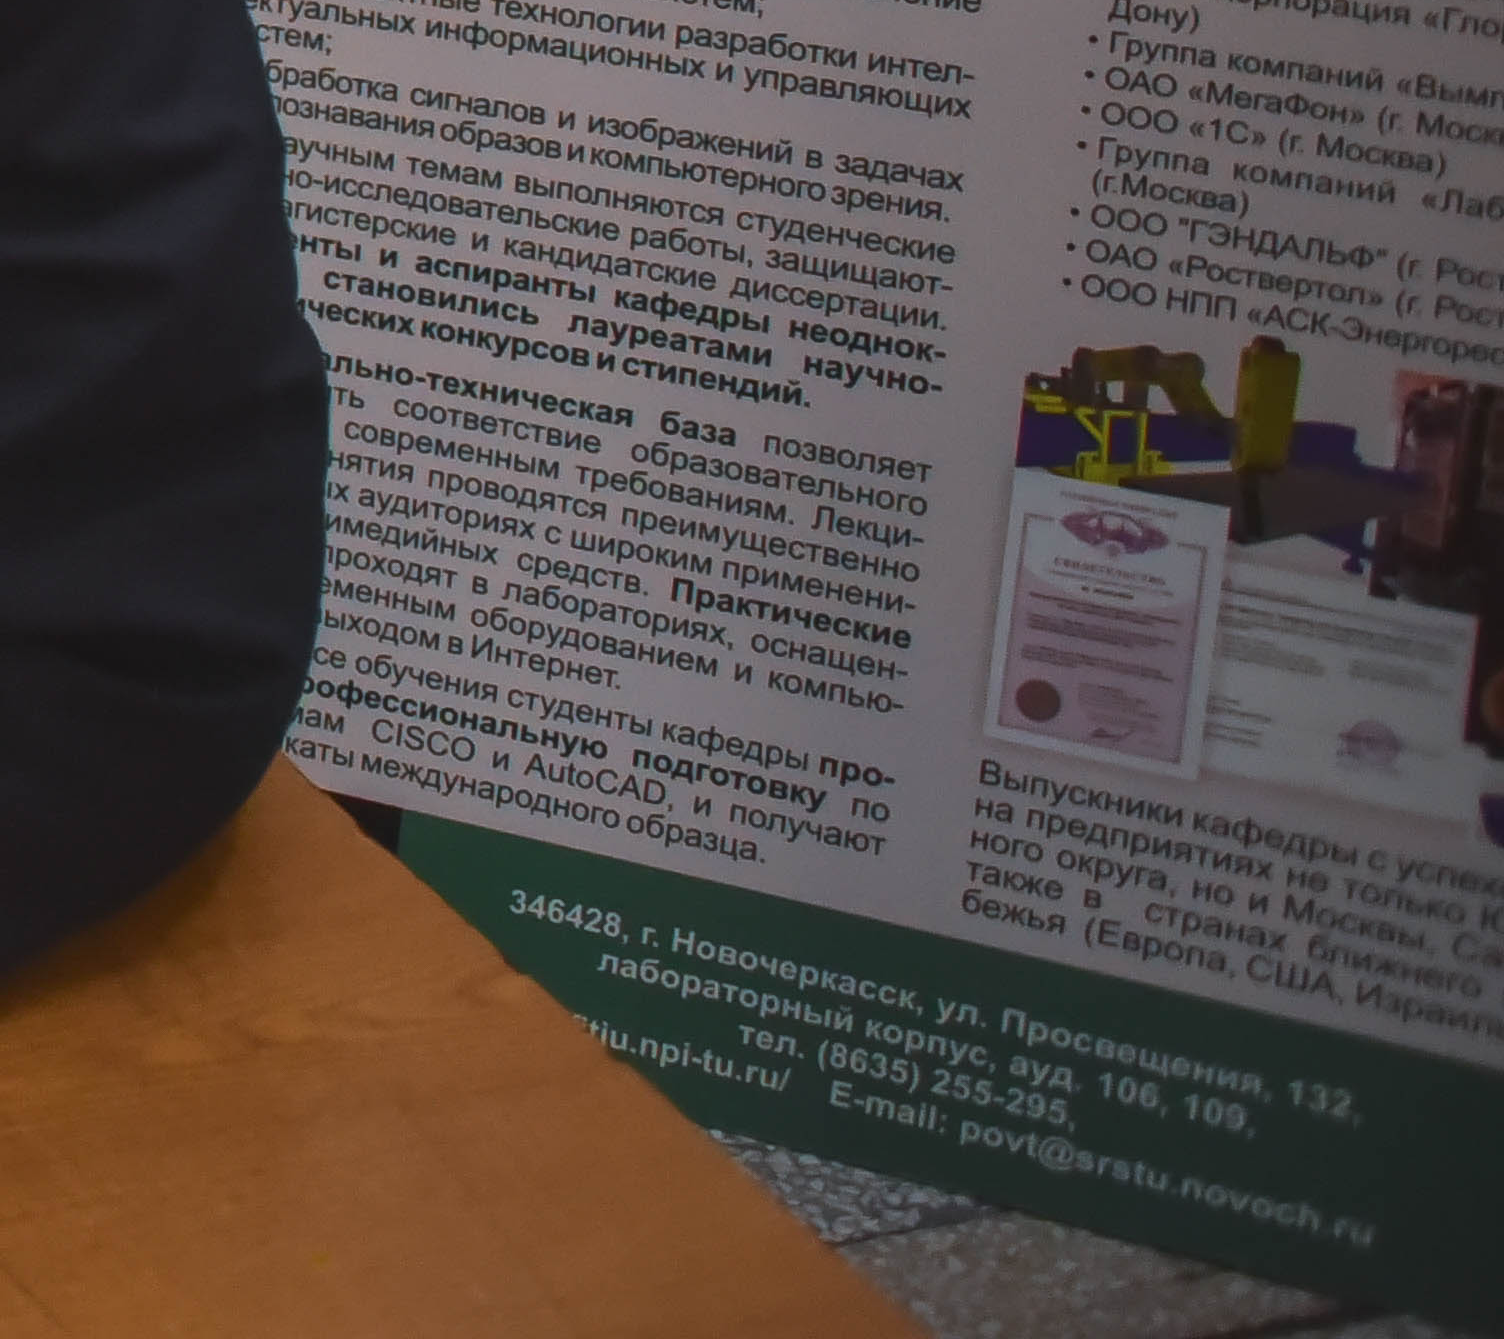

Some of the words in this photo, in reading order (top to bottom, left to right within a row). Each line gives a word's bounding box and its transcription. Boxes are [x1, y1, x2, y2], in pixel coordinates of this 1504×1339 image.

[1100, 101, 1181, 135] ООО
[1189, 117, 1266, 147] «1С»
[1278, 127, 1303, 157] (г.
[1316, 131, 1446, 179] Москва)
[371, 722, 475, 762] CISCO
[492, 750, 509, 771] и
[523, 754, 672, 812] AutoCAD,
[693, 795, 711, 817] и
[729, 803, 886, 855] получают
[509, 889, 628, 944] 346428,
[641, 926, 658, 947] г.
[671, 927, 922, 1015] Новочеркасск,
[936, 998, 986, 1027] ул.
[1001, 1008, 1266, 1101] Просвещения,
[1289, 1080, 1362, 1127] 132,
[596, 953, 853, 1032] лабораторный
[865, 1019, 995, 1073] корпус,
[1010, 1052, 1081, 1092] ауд.
[1099, 1072, 1165, 1115] 106,
[1185, 1093, 1255, 1139] 109,
[738, 1024, 804, 1059] тел.
[818, 1039, 920, 1093] (8635)
[930, 1069, 1074, 1131] 255-295,
